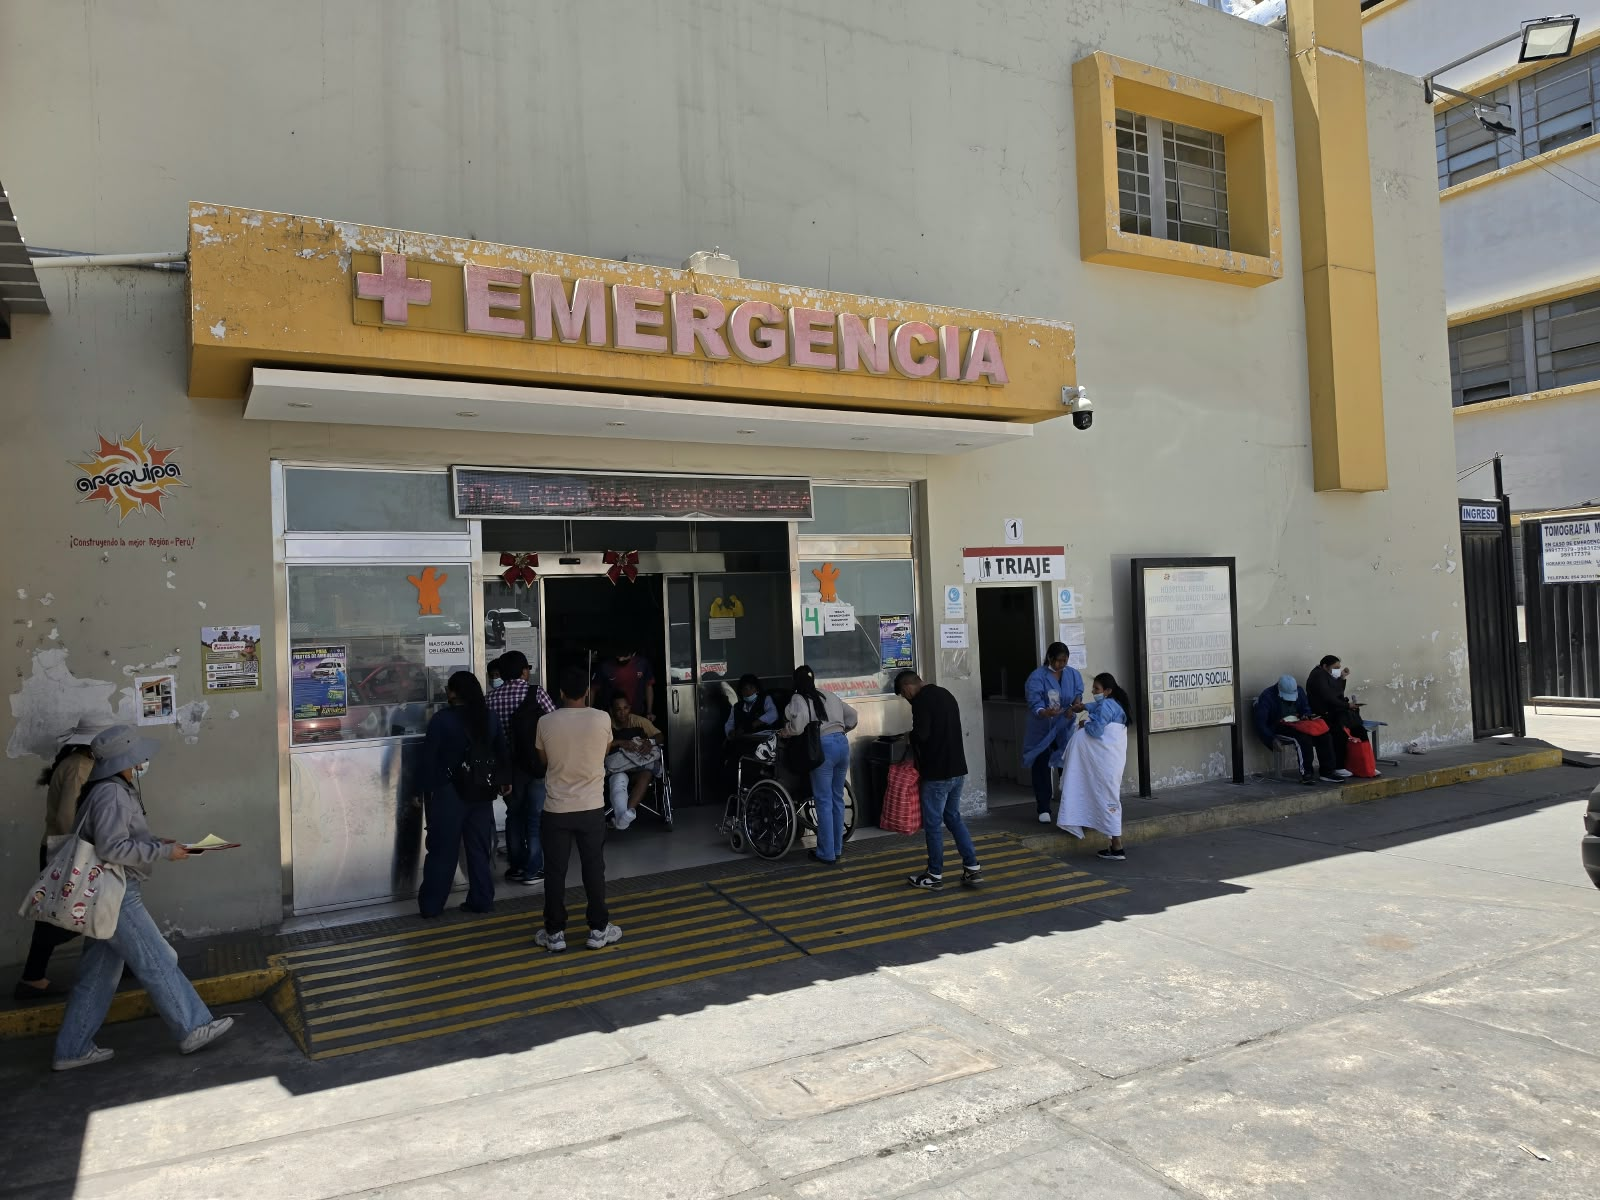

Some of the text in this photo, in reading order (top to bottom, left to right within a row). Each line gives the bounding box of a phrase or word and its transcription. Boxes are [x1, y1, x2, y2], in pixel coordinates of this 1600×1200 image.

[463, 263, 1009, 385] EMERGENCIA
[1463, 508, 1496, 520] INGRESO
[1010, 522, 1017, 538] 1
[1544, 523, 1590, 537] TOMOGRAFIA
[70, 535, 118, 548] ¡Construyendo
[119, 538, 126, 546] la
[128, 538, 146, 548] mejor
[995, 557, 1051, 578] TRIAJE
[805, 607, 819, 635] 4
[1205, 670, 1231, 685] SOCIAL
